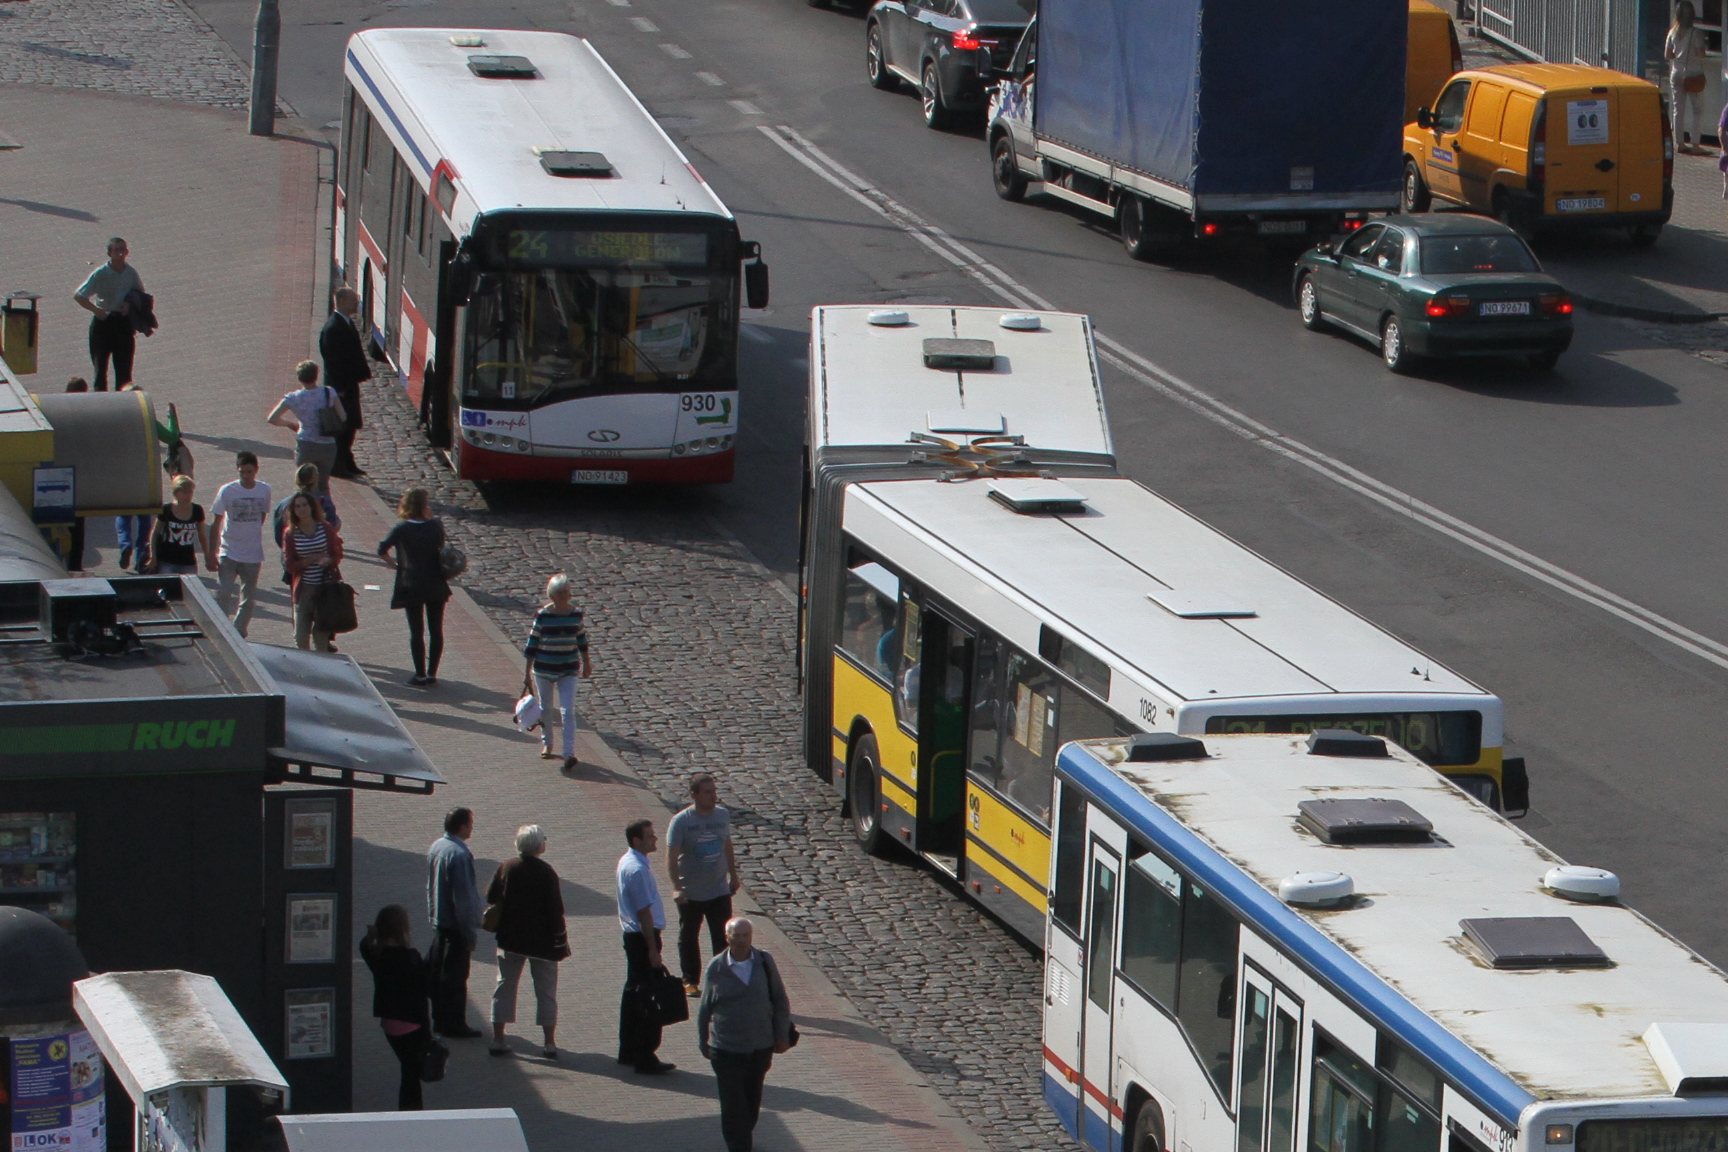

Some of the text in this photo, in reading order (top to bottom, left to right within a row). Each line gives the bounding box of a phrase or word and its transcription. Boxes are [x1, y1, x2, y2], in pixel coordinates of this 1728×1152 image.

[681, 394, 716, 412] 930
[1140, 697, 1157, 726] 1082
[134, 719, 237, 750] RUCH
